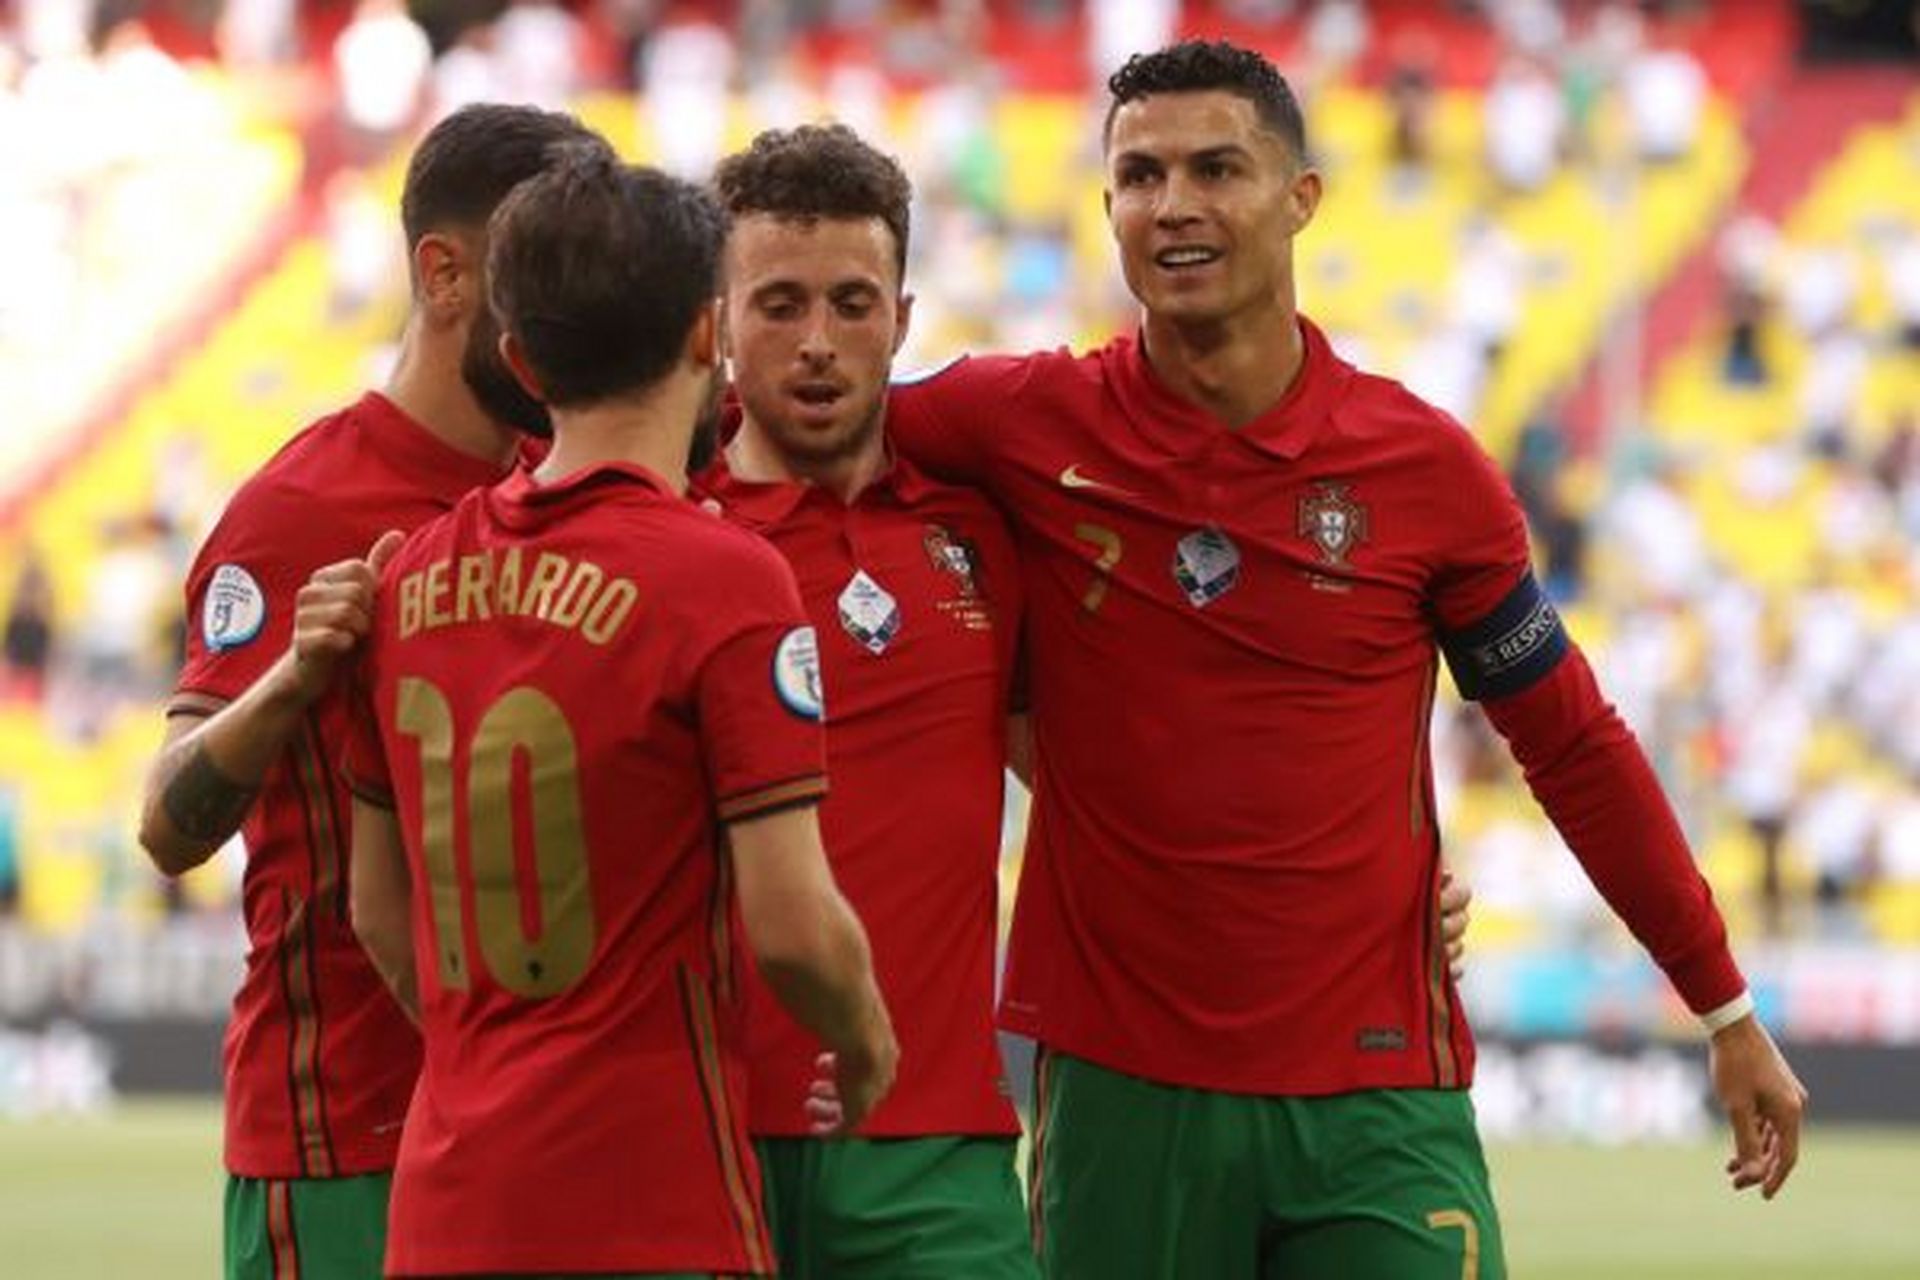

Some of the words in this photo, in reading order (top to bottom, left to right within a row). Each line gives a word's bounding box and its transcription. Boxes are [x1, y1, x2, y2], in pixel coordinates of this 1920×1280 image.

[1074, 523, 1122, 611] 7
[395, 677, 597, 999] 10
[1426, 1209, 1479, 1280] 7
